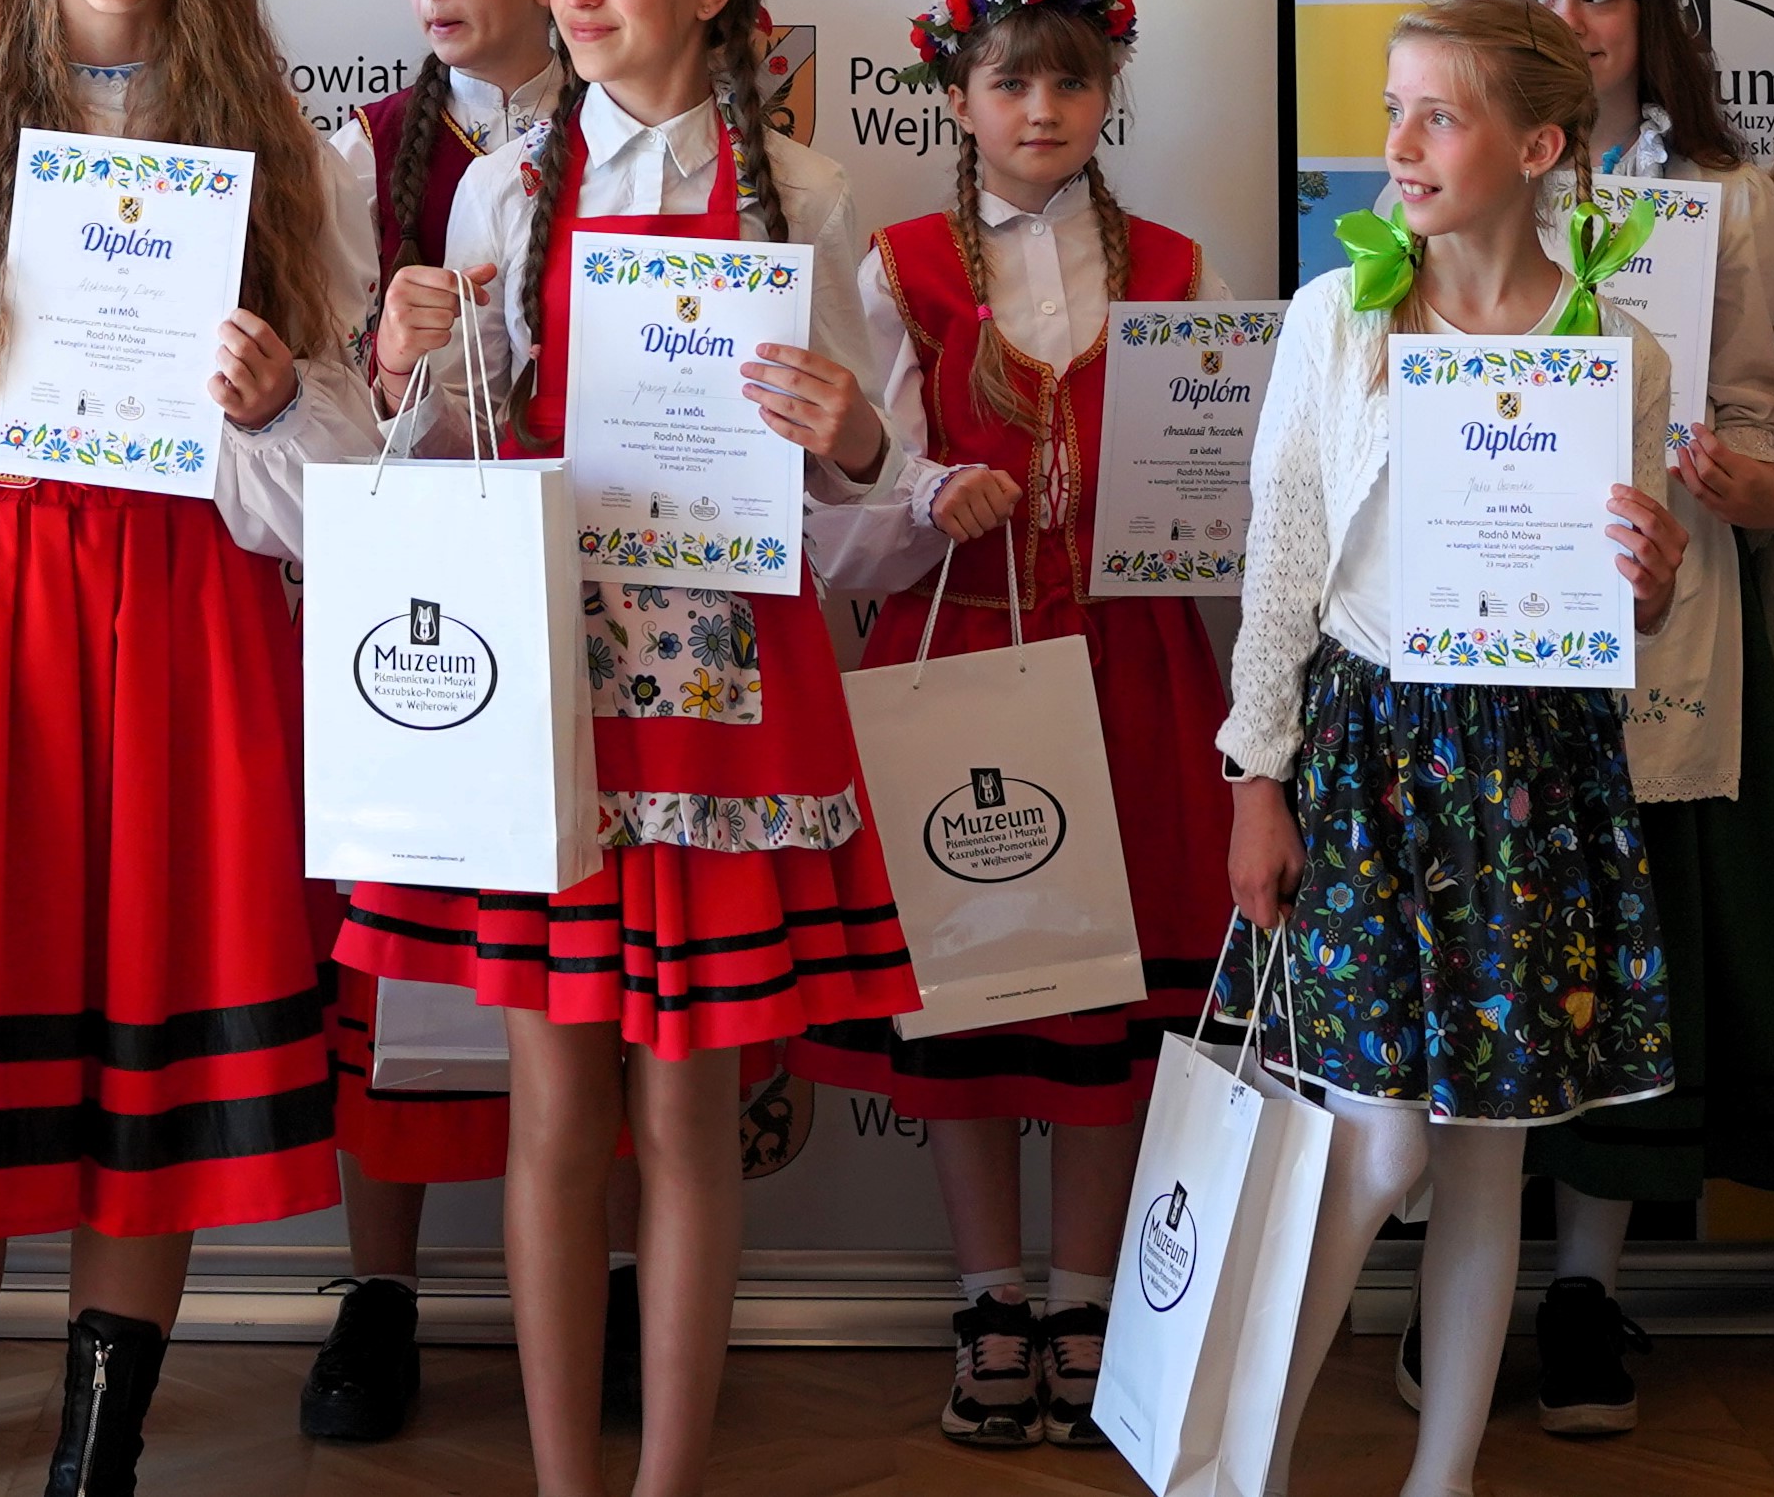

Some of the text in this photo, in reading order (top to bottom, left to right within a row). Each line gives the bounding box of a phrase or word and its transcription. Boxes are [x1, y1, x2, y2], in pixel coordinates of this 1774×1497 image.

[82, 222, 173, 261] Diplóm
[98, 307, 108, 315] za
[110, 307, 116, 315] II
[641, 324, 735, 362] Diplóm
[1169, 376, 1250, 409] Diplóm
[666, 408, 675, 416] za
[684, 406, 705, 418] MÔL
[1462, 421, 1557, 460] Diplóm
[1499, 504, 1508, 513] III
[1511, 503, 1533, 513] MÔL
[1478, 528, 1541, 540] Rodnô Mòwa
[374, 644, 476, 674] Muzeum
[443, 675, 476, 688] Muzyki
[374, 686, 476, 701] Kaszubsko-Pomorskiej
[407, 701, 458, 712] Wejherowie
[941, 805, 1044, 838] Muzeum
[1015, 825, 1046, 838] Muzyki
[948, 836, 1048, 861] Kaszubsko-Pomorskiej
[981, 851, 1033, 868] Wejherowie
[1148, 1213, 1188, 1269] Muzeum
